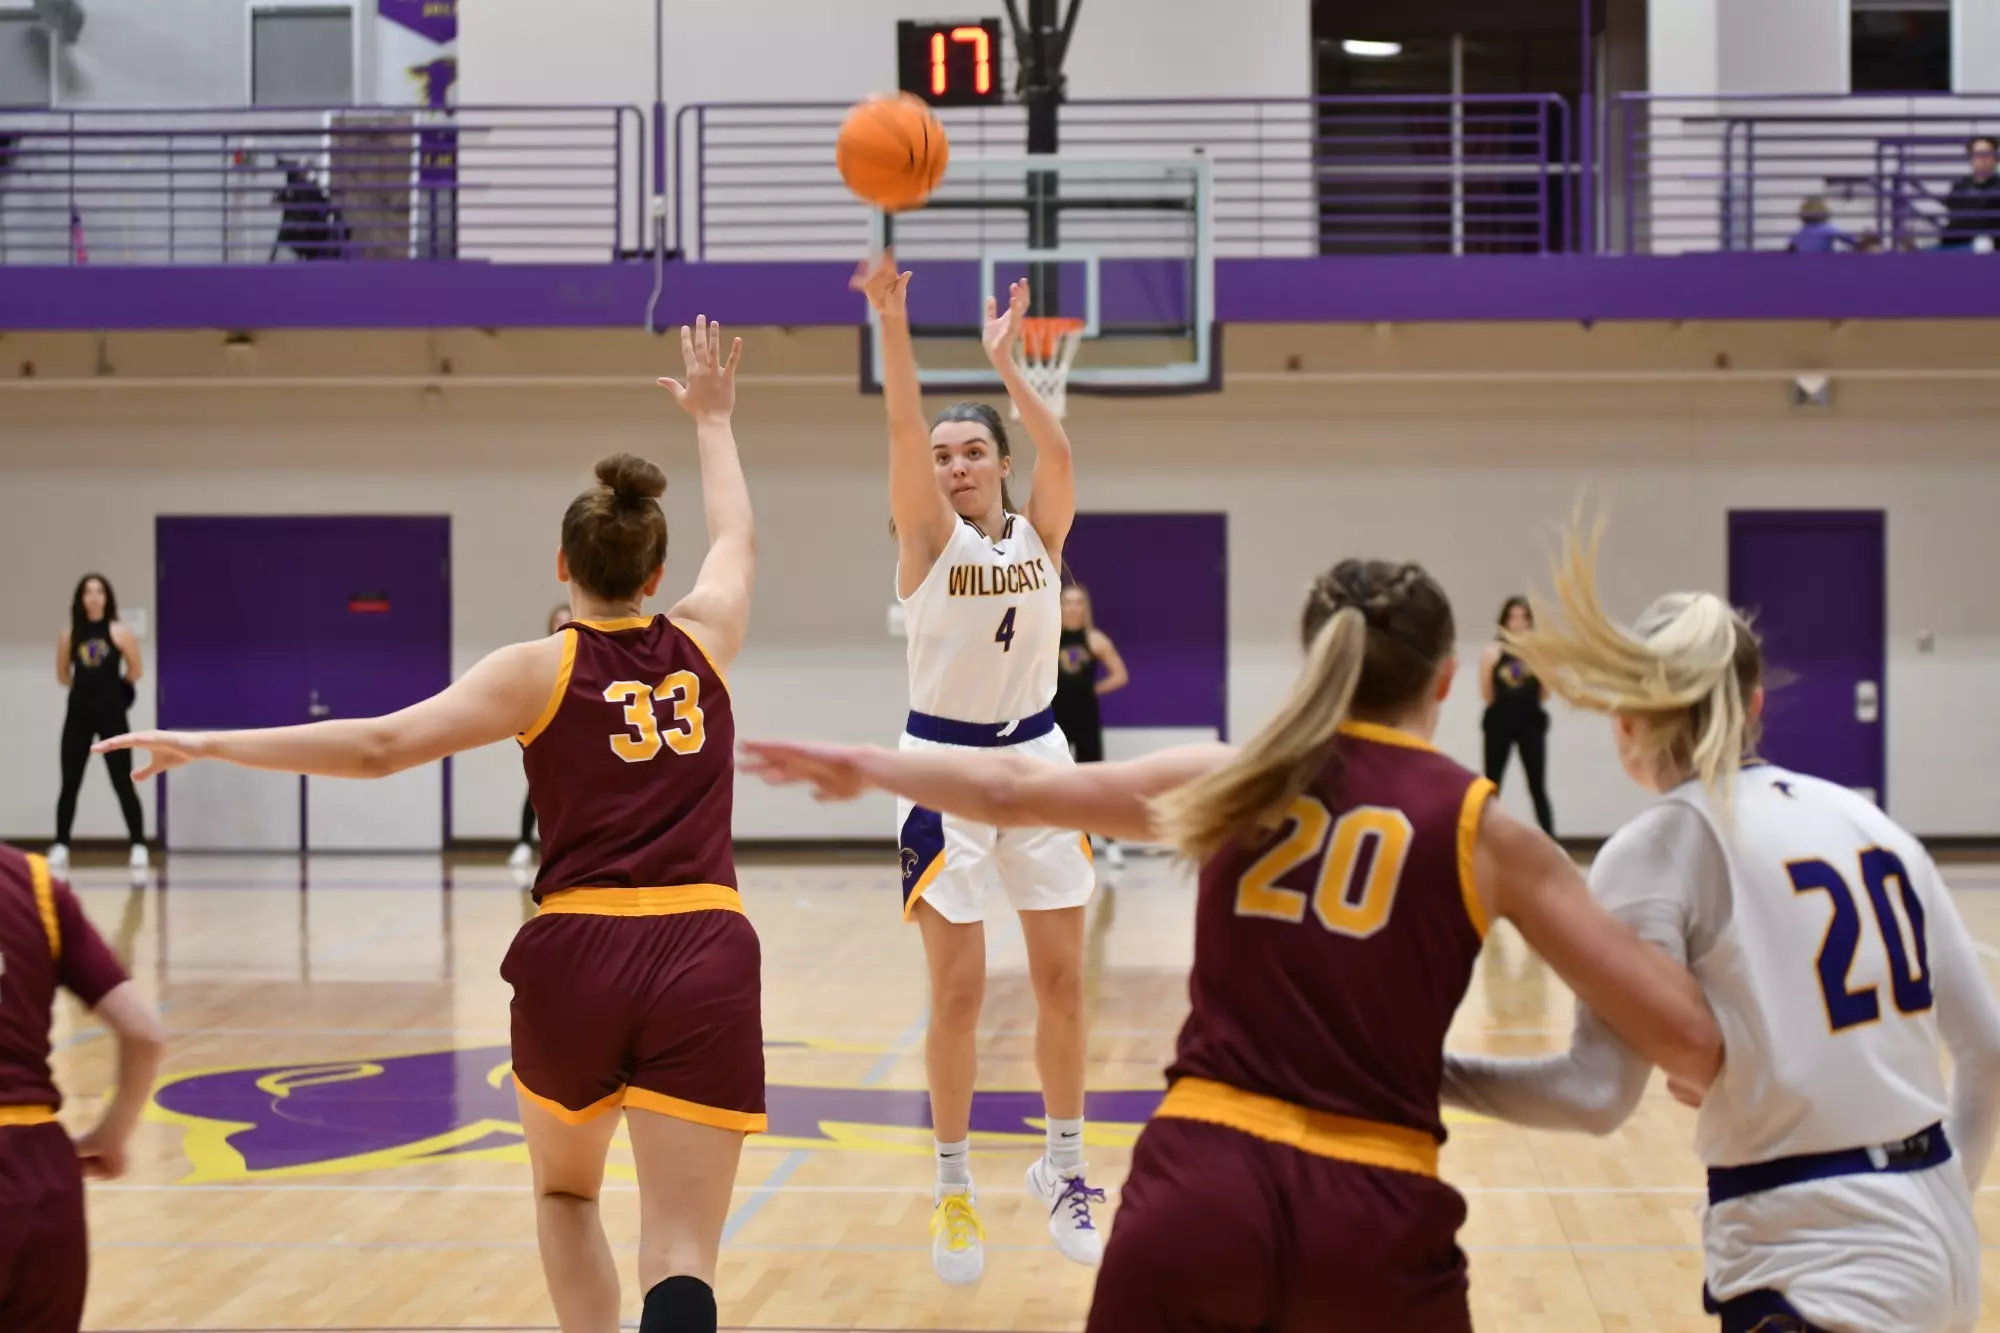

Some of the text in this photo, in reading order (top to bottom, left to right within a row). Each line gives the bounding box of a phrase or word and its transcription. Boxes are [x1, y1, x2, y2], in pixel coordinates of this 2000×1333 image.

[931, 27, 990, 95] 17
[994, 606, 1016, 653] 4
[602, 669, 706, 763] 33
[1234, 794, 1415, 939] 20
[1782, 843, 1933, 1034] 20
